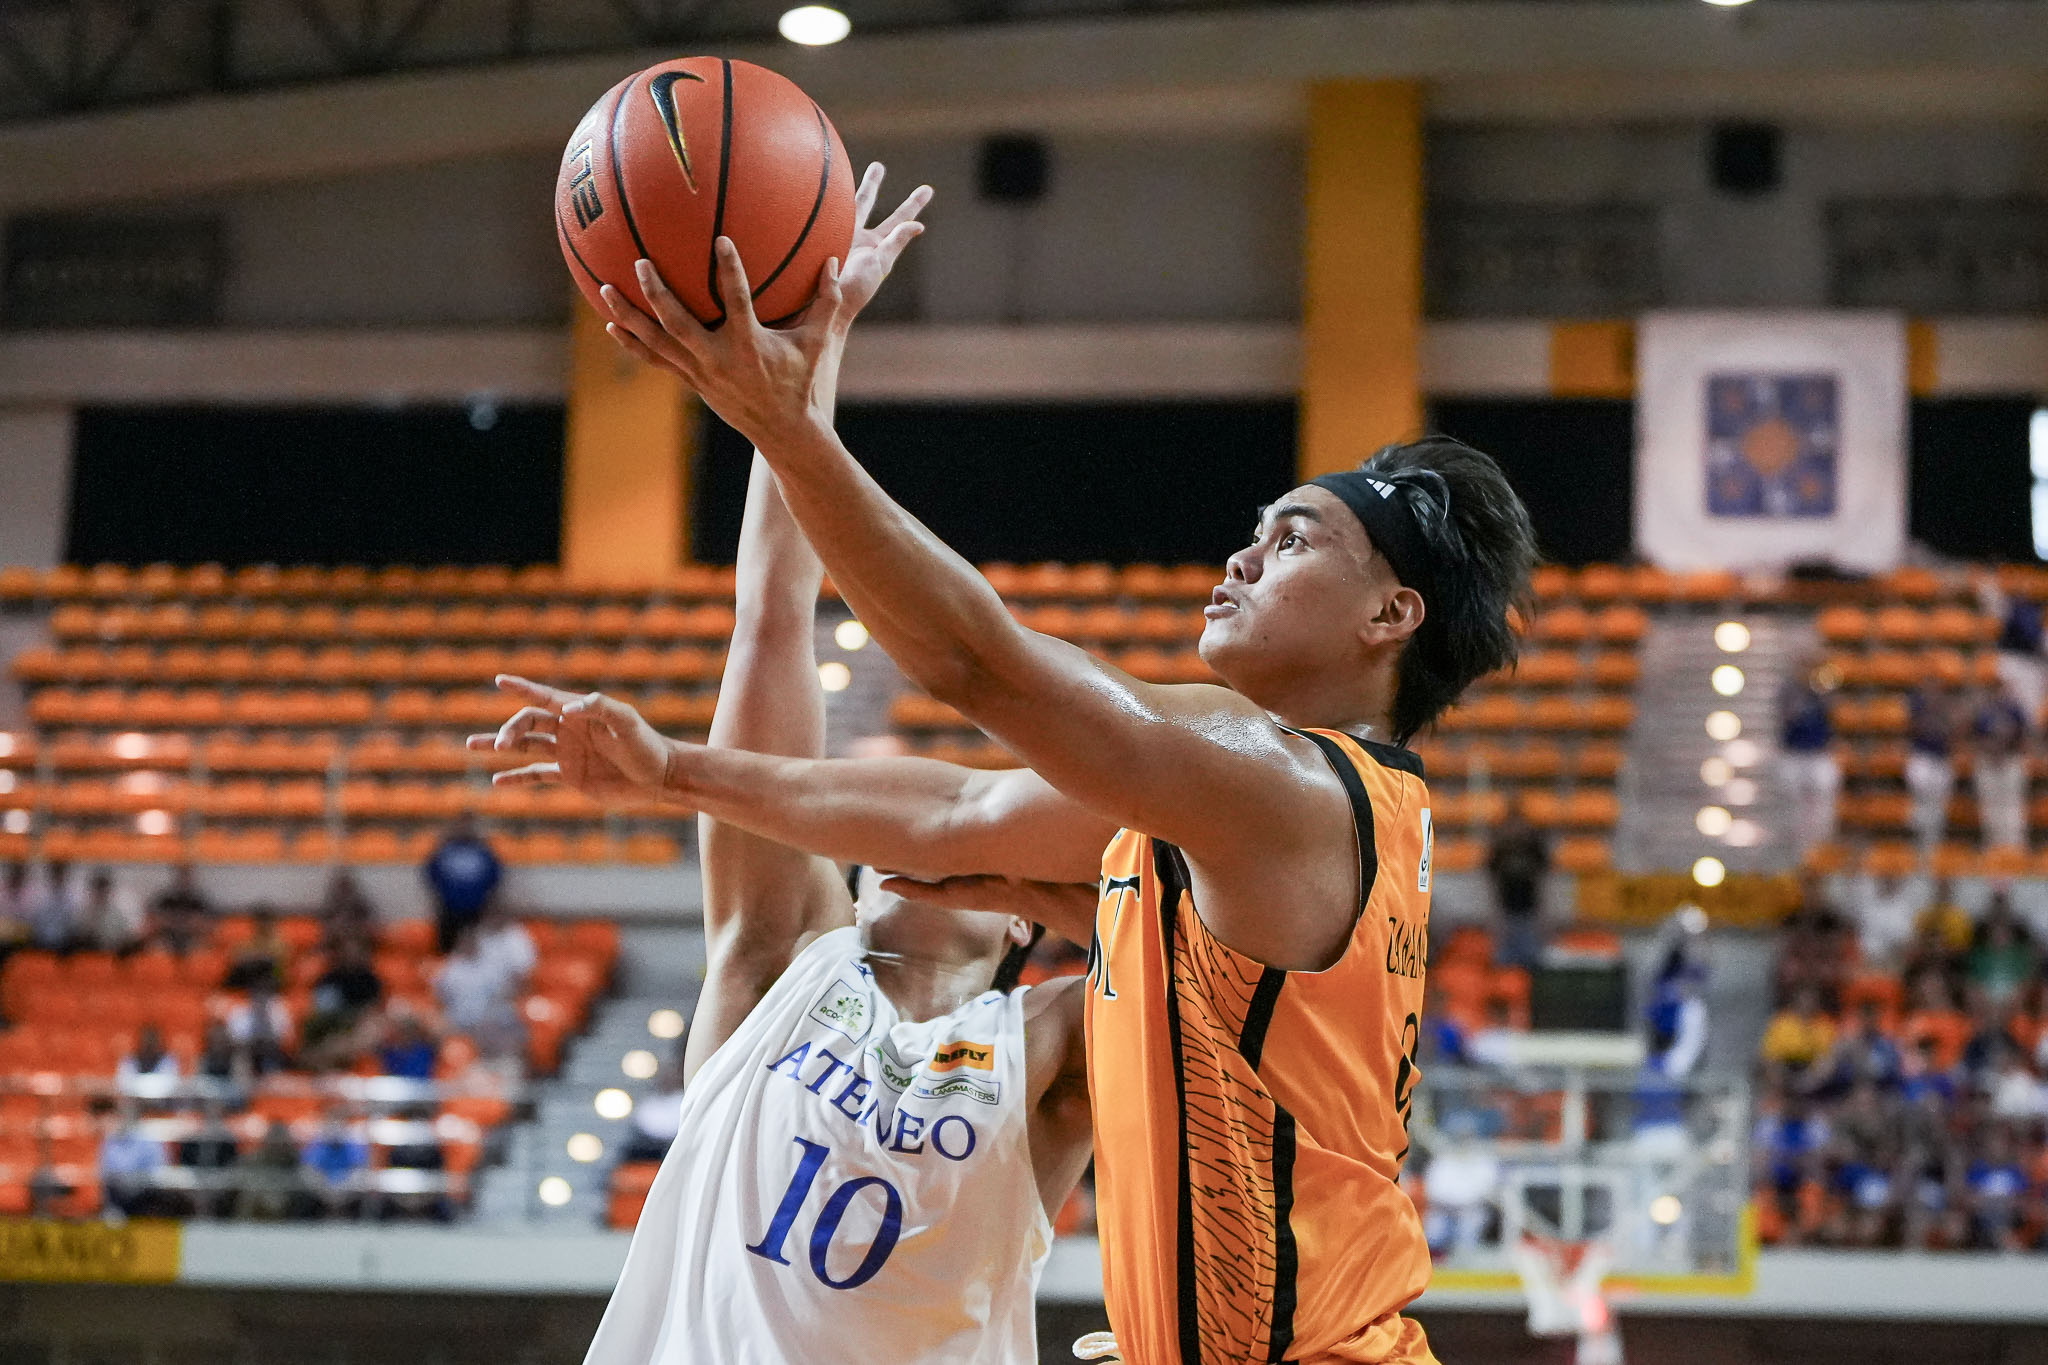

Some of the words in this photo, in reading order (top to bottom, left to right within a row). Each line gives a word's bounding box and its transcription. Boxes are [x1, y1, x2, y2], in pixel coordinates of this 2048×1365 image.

[933, 1048, 988, 1064] IREFLY
[933, 1080, 996, 1102] LANDMASTERS
[766, 1041, 977, 1162] ATENEO
[745, 1136, 903, 1291] 10
